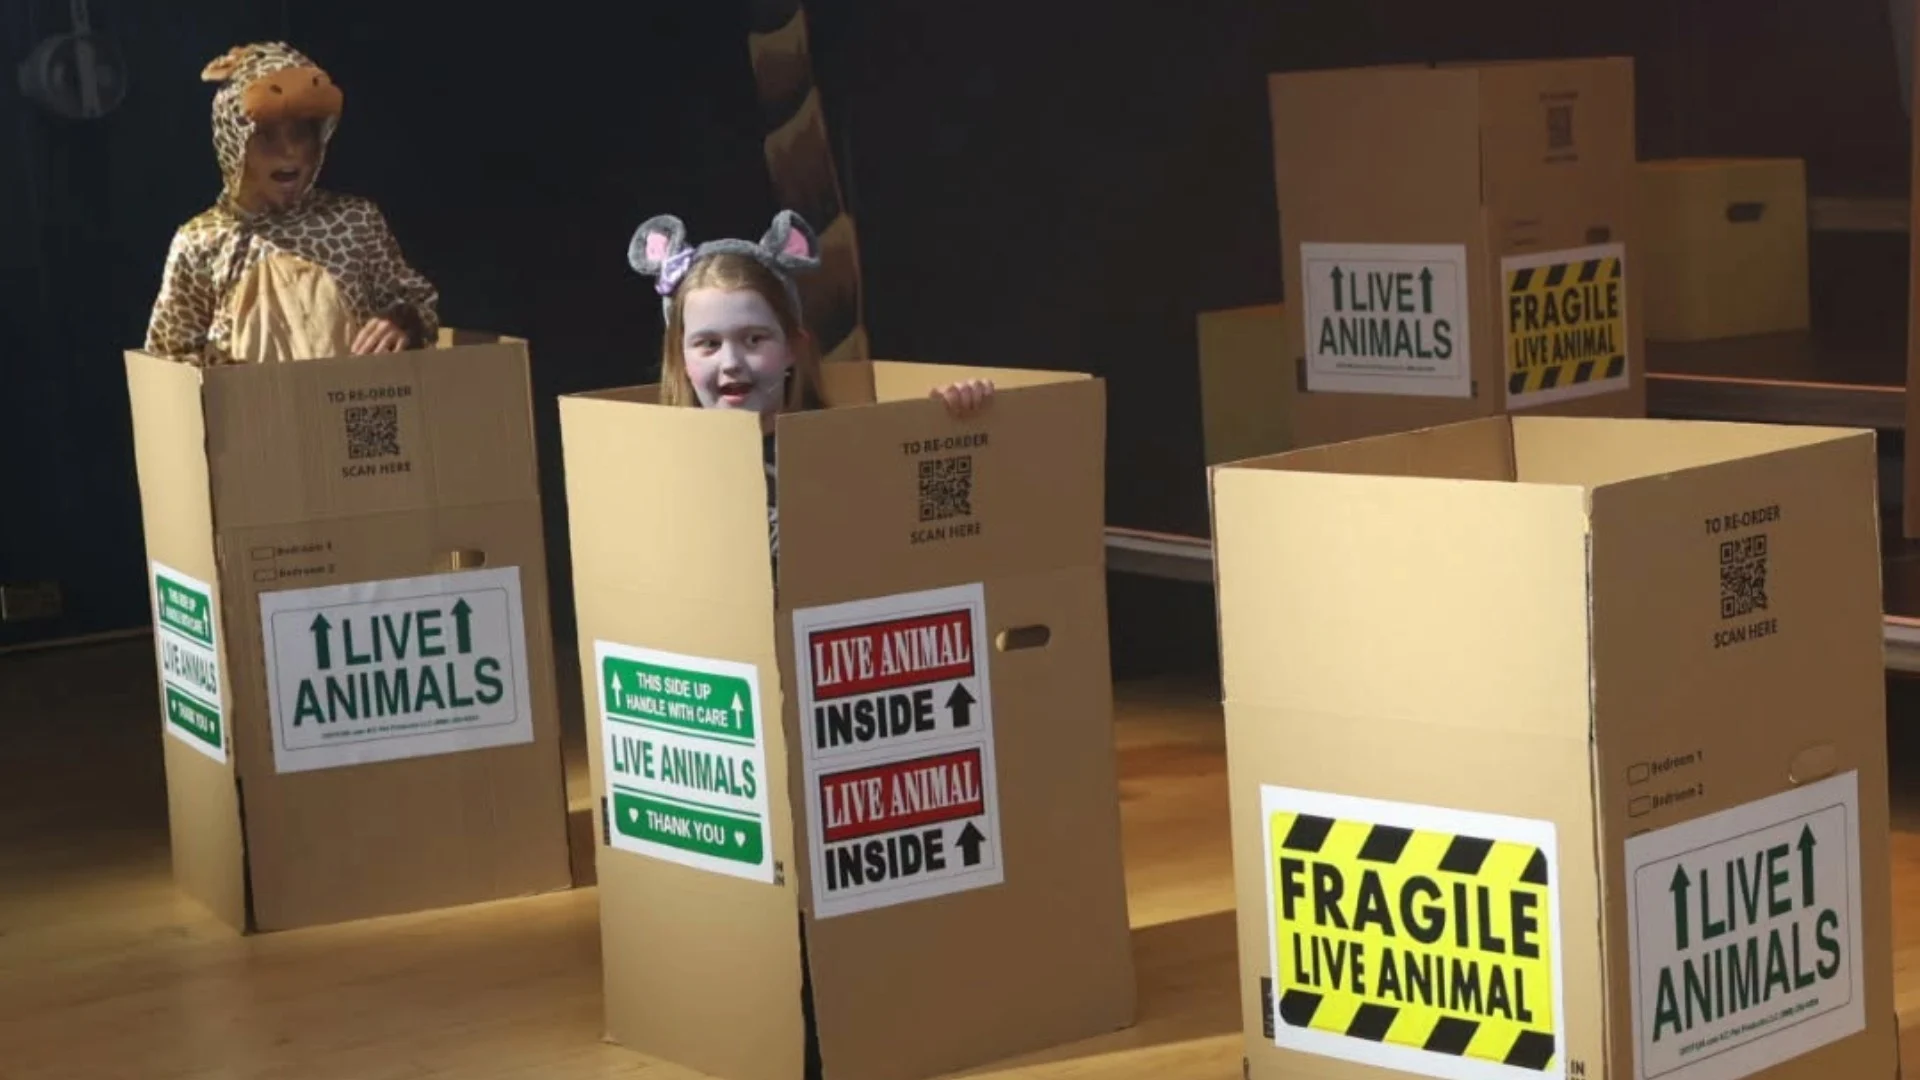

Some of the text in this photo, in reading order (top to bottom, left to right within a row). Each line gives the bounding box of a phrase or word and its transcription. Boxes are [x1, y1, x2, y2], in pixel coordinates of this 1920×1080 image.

[1350, 271, 1415, 312] LIVE
[1509, 283, 1619, 332] FRAGILE
[1319, 316, 1452, 359] ANIMALS
[1514, 324, 1615, 368] LIVE ANIMAL
[327, 386, 411, 403] TO RE-ORDER
[903, 434, 988, 455] TO RE-ORDER
[342, 461, 411, 478] SCAN HERE
[911, 522, 980, 544] SCAN HERE
[1704, 505, 1780, 534] TO RE-ORDER
[277, 543, 324, 556] Bedroom
[279, 566, 325, 578] Bedroom
[342, 609, 445, 665] LIVE
[814, 622, 970, 686] LIVE ANIMAL
[1714, 618, 1777, 649] SCAN HERE
[293, 646, 503, 727] ANIMALS
[636, 671, 712, 699] THIS SIDE UP
[625, 693, 728, 727] HANDLE WITH CARE
[815, 689, 935, 750] INSIDE
[611, 733, 757, 800] LIVE ANIMALS
[1652, 754, 1694, 776] Bedroom
[824, 761, 980, 829] LIVE ANIMAL
[1653, 788, 1696, 809] Bedroom
[646, 810, 726, 845] THANK YOU
[825, 829, 946, 891] INSIDE
[1280, 857, 1540, 960] FRAGILE
[1700, 843, 1793, 940] LIVE
[1293, 932, 1533, 1024] LIVE ANIMAL
[1652, 909, 1841, 1043] ANIMALS
[1570, 1060, 1585, 1077] IN
